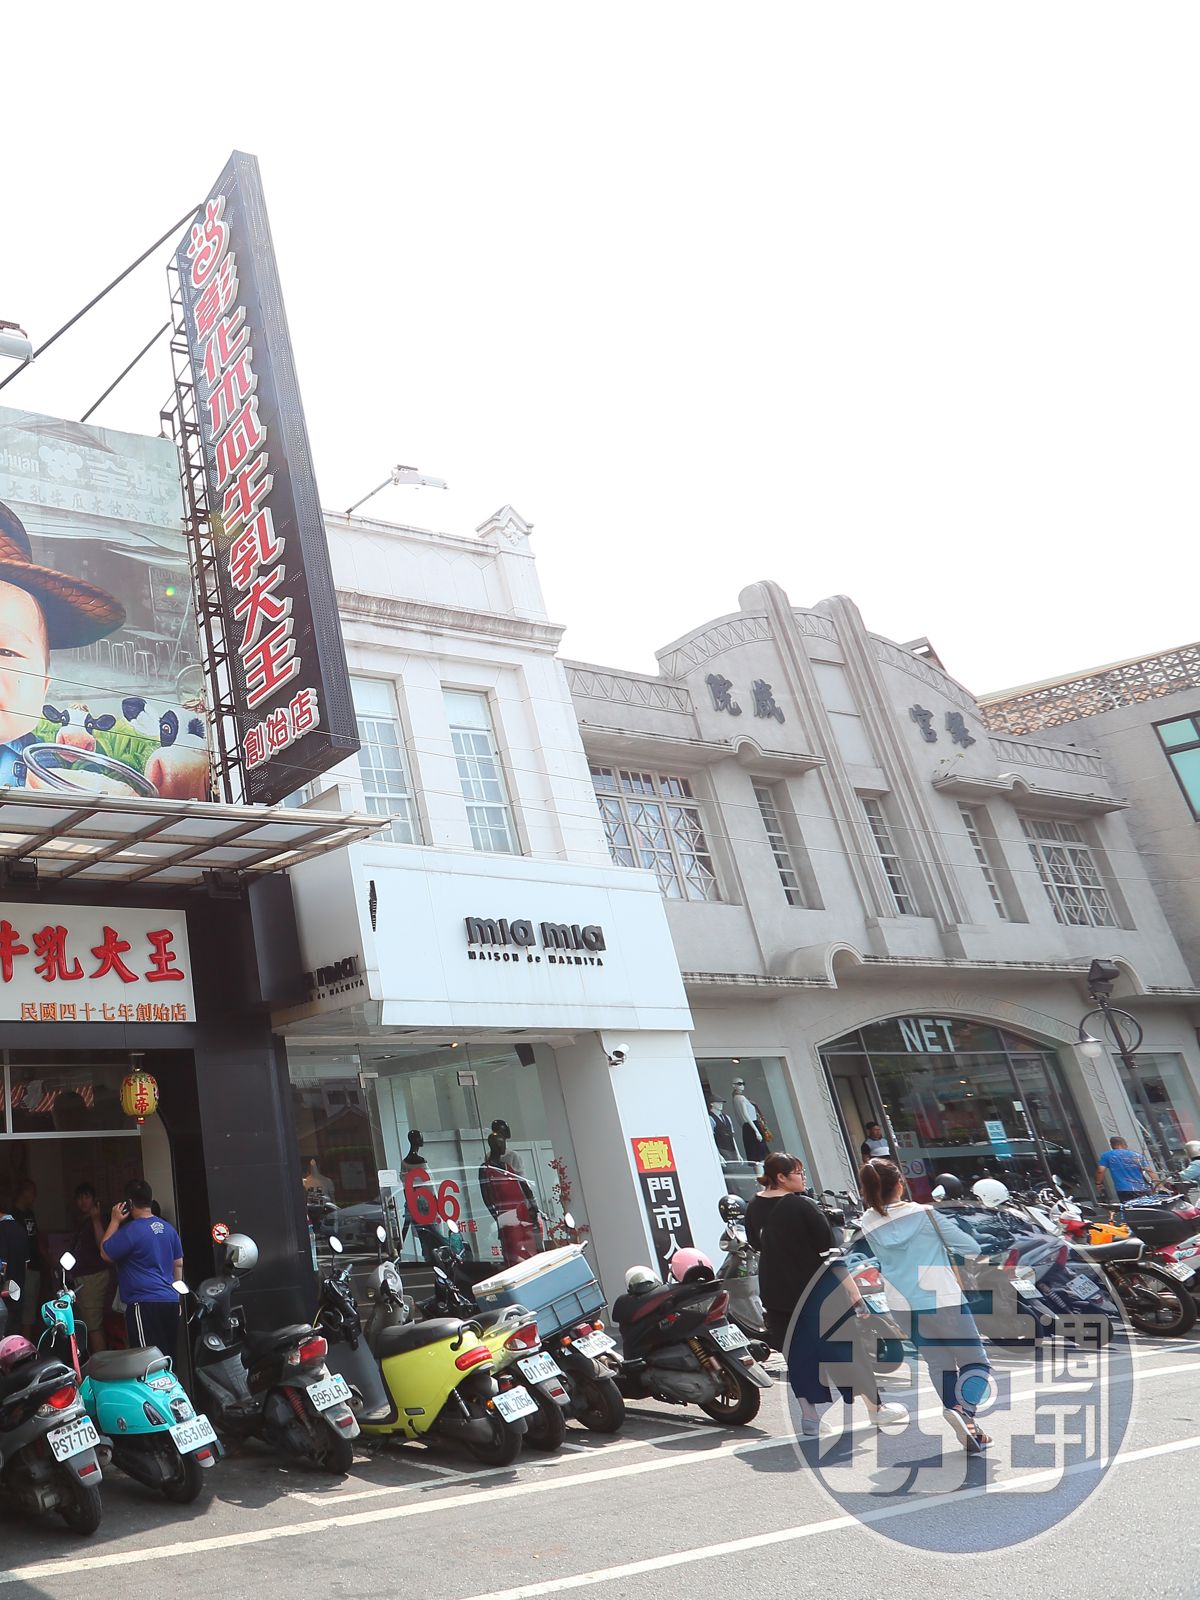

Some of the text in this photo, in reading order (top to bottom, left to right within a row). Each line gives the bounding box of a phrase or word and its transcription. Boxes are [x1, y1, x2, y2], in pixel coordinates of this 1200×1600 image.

[242, 687, 320, 771] 創始店
[20, 1001, 188, 1023] 民國四十七年創始店
[897, 1018, 956, 1053] NET
[647, 1176, 682, 1284] 門市人
